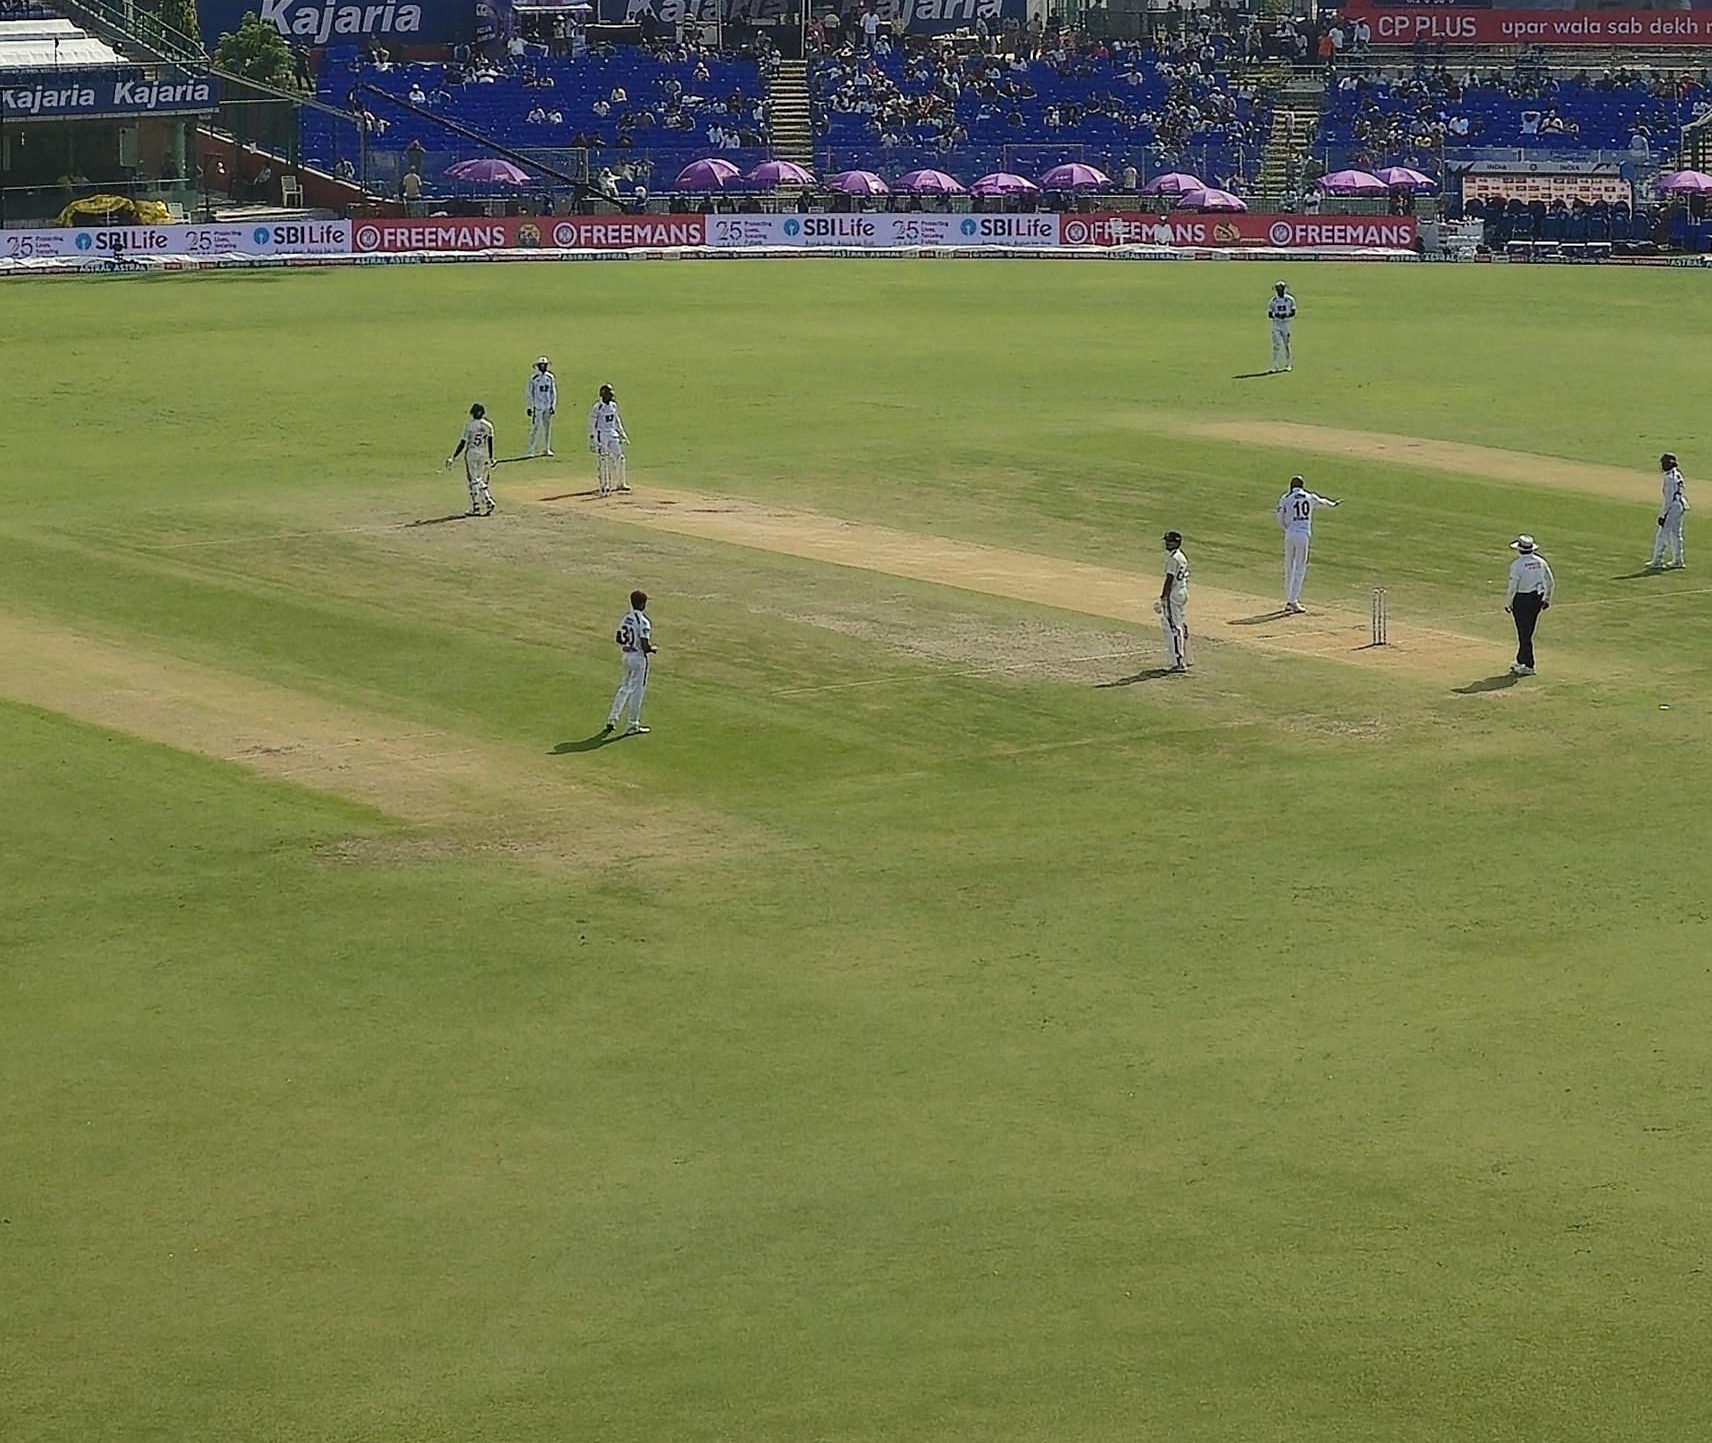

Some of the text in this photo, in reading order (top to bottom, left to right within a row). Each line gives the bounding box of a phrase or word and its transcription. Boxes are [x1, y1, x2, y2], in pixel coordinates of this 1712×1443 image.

[1378, 16, 1477, 37] CP PLUS
[1502, 21, 1548, 38] upar
[1553, 17, 1601, 35] wala
[1607, 17, 1643, 35] sab
[1650, 17, 1698, 35] dekh
[113, 78, 210, 107] Kajaria
[273, 227, 305, 245] SBI
[309, 225, 345, 244] Life
[384, 226, 505, 247] FREEMANS
[580, 223, 701, 245] FREEMANS
[803, 217, 836, 237] SBI
[840, 218, 875, 237] Life
[980, 218, 1013, 238] SBI
[1016, 218, 1052, 238] Life
[1295, 224, 1412, 244] FREEMANS
[131, 230, 168, 250] Life
[1293, 500, 1310, 517] 10
